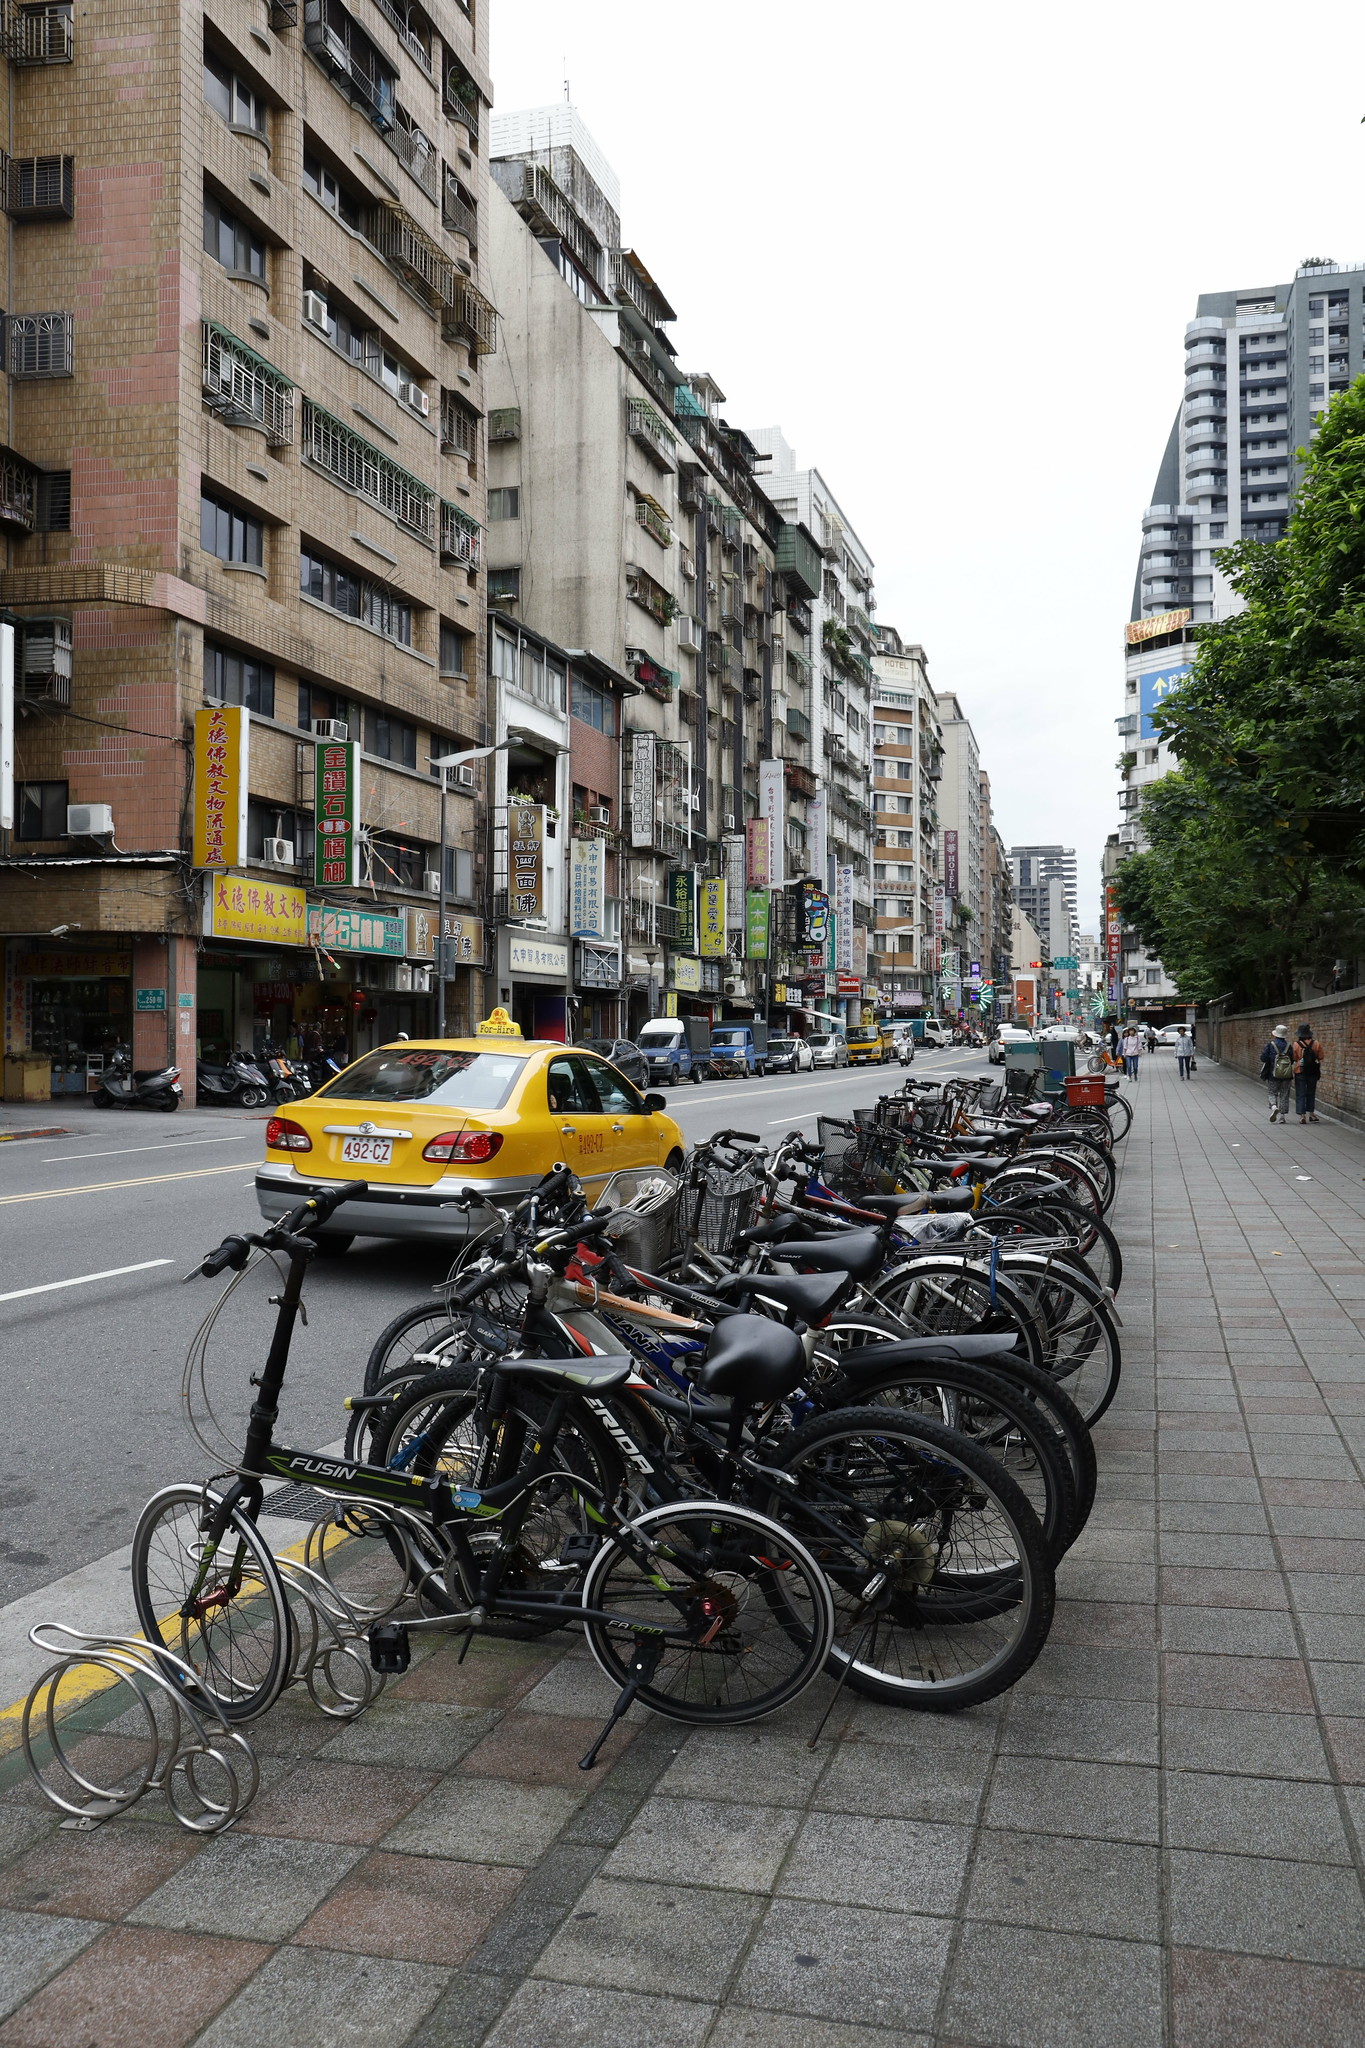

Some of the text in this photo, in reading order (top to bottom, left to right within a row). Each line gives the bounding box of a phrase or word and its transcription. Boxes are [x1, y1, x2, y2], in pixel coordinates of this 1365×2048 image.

[885, 660, 909, 669] HOTEL
[205, 711, 229, 864] 大德佛教文物流通處
[323, 747, 346, 816] 金鑽石
[323, 838, 346, 883] 檳榔
[515, 855, 537, 914] 四面佛
[217, 883, 303, 919] 大德佛教文物
[809, 954, 823, 967] 新
[480, 1025, 515, 1034] For-Hire
[399, 1053, 476, 1069] 492-CZ
[343, 1141, 390, 1161] 492-CZ
[476, 1327, 498, 1341] GIANT
[586, 1396, 652, 1476] ERIDA
[289, 1456, 358, 1481] FUSIN
